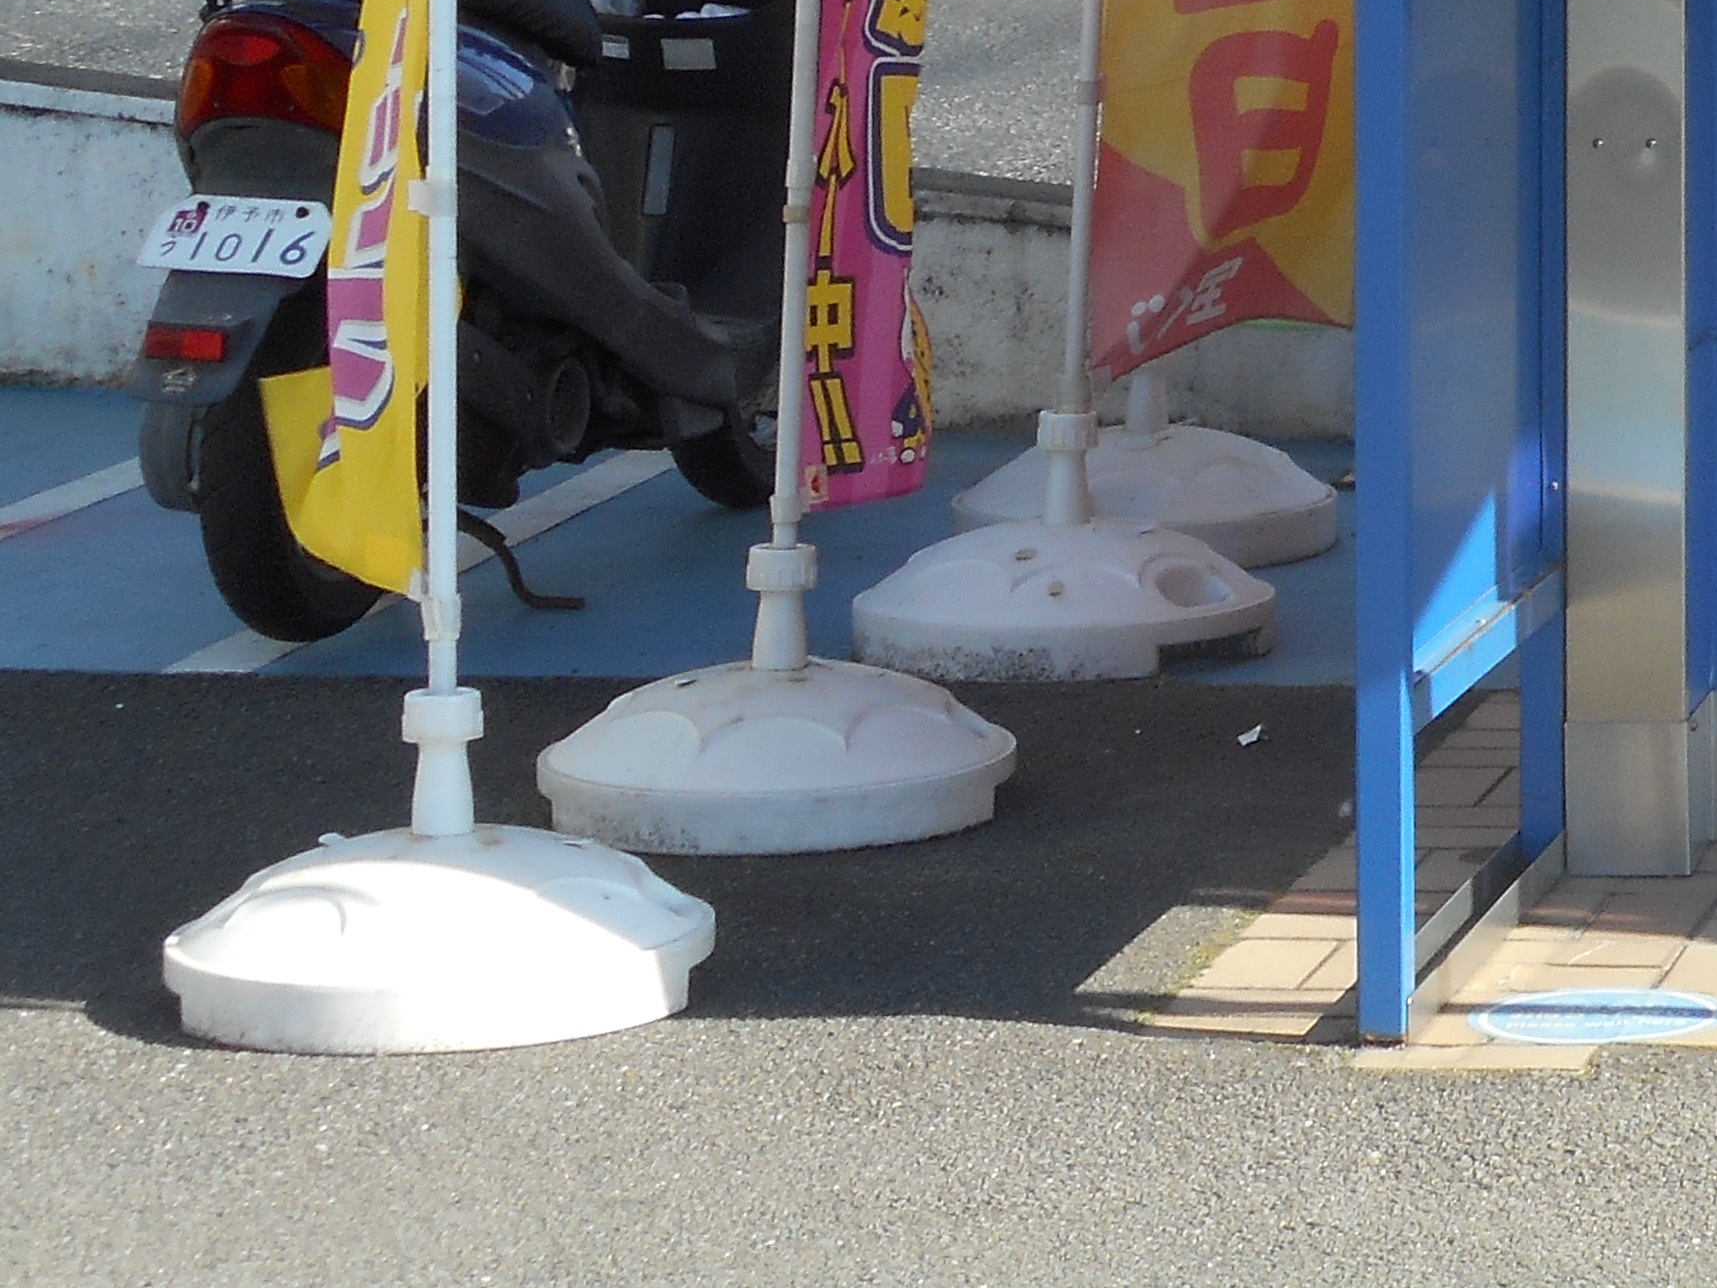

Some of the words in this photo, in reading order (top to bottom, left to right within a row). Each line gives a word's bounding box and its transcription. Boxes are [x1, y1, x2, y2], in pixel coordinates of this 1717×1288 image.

[215, 204, 284, 225] 伊予市
[189, 227, 316, 265] 1016
